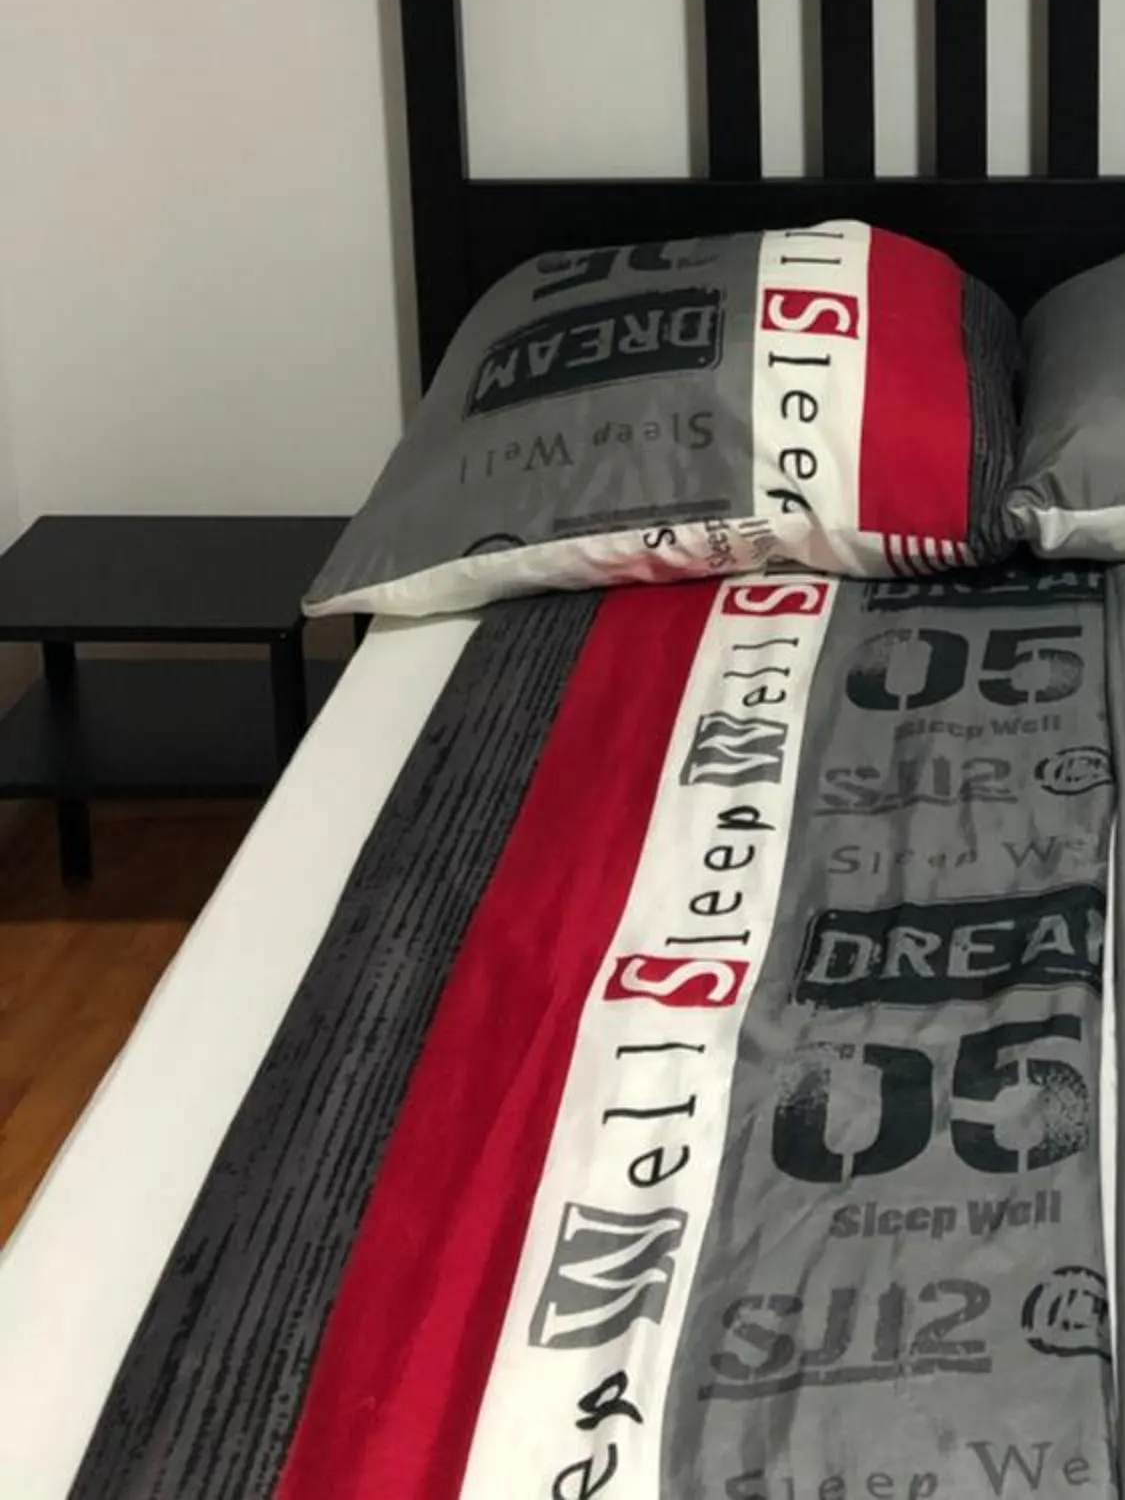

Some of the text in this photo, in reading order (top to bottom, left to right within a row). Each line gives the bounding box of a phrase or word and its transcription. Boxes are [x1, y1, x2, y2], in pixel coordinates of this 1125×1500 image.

[477, 304, 715, 394] DREAM
[459, 409, 714, 485] Sleep Well
[682, 636, 800, 786] Well
[844, 625, 1086, 711] 05
[619, 803, 777, 1004] Sleep
[805, 912, 1106, 986] DREA
[771, 1014, 1090, 1183] 05
[532, 1043, 707, 1348] Well
[831, 1190, 1062, 1239] Sleep Well
